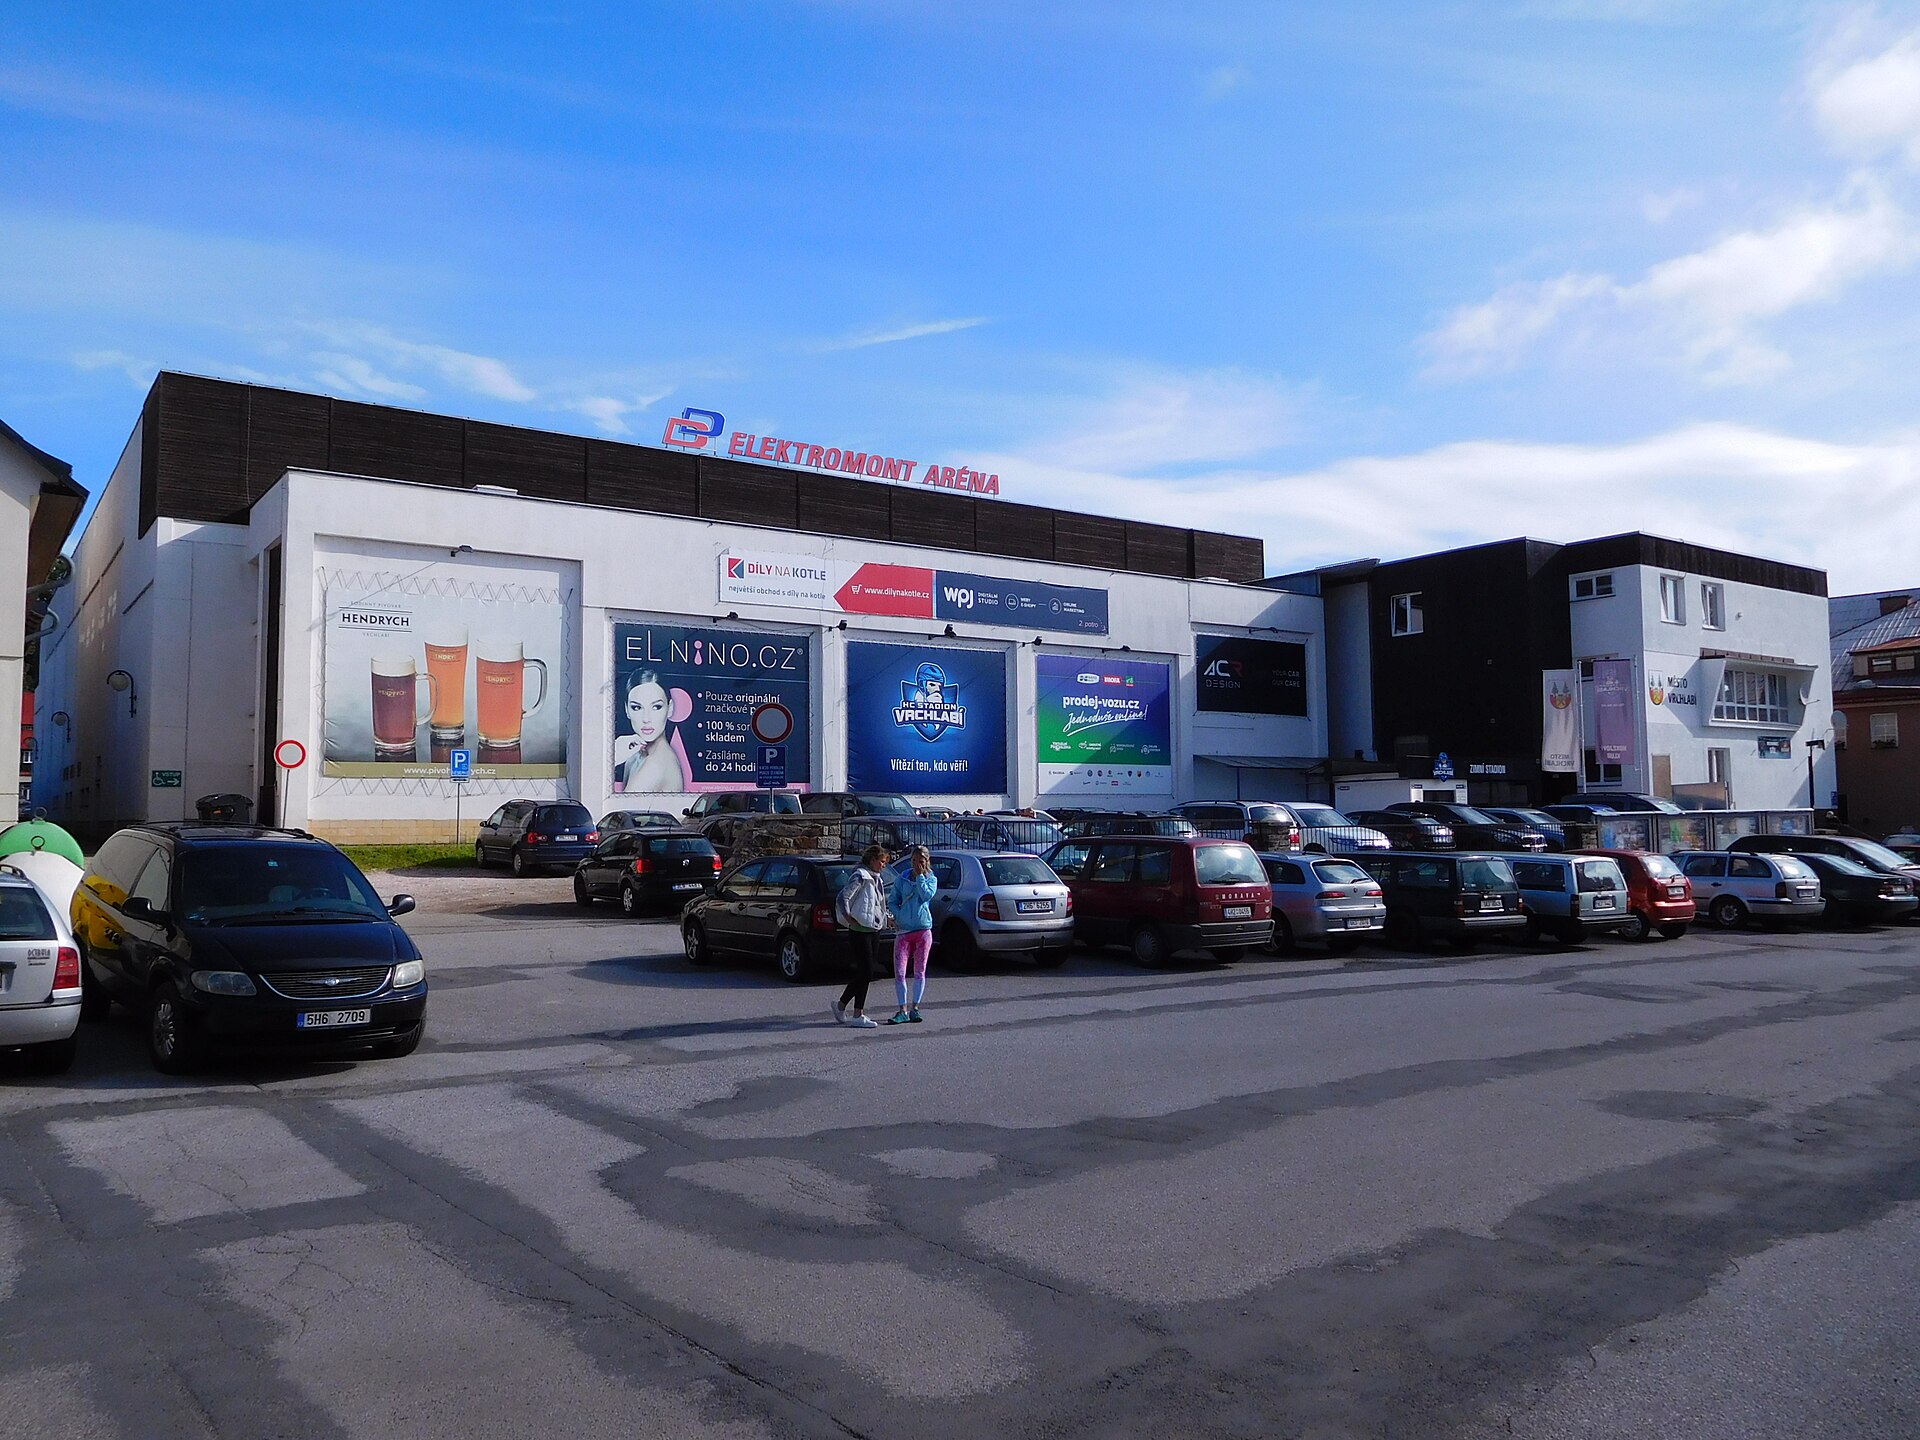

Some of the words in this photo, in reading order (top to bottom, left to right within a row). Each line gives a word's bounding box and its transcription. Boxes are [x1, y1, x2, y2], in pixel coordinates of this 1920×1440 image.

[728, 431, 917, 482] ELEKTROMONT
[922, 464, 1000, 495] ARÉNA
[748, 562, 773, 575] DÍLY
[775, 566, 791, 577] NA
[792, 567, 826, 580] KOTLE
[728, 585, 756, 594] největší
[756, 587, 781, 595] obchod
[787, 590, 799, 598] díly
[809, 592, 826, 600] kotle
[864, 587, 930, 599] www.dilynakotle.cz
[342, 613, 410, 627] HENDRYCH
[626, 630, 662, 662] EL
[1205, 679, 1241, 689] DESIGN
[705, 691, 733, 702] Pouze
[735, 692, 780, 705] originální
[1062, 695, 1140, 709] prodej-vozu.cz
[705, 703, 748, 714] značkové
[917, 702, 957, 710] STADION
[895, 708, 964, 726] VRCHLABÍ
[706, 720, 724, 731] 100
[725, 721, 735, 731] %
[705, 731, 746, 742] skladem
[454, 752, 467, 768] P
[705, 749, 746, 760] Zasíláme
[766, 748, 778, 763] P
[705, 762, 719, 772] do
[720, 762, 733, 772] 24
[735, 762, 756, 772] hodi
[890, 759, 915, 771] Vítězí
[915, 760, 932, 773] ten,
[933, 760, 948, 772] kdo
[949, 760, 968, 772] věří!
[1469, 763, 1485, 774] ZIMNÍ
[1485, 764, 1506, 774] STADION
[306, 1013, 329, 1026] 5H6
[337, 1010, 365, 1024] 2709
